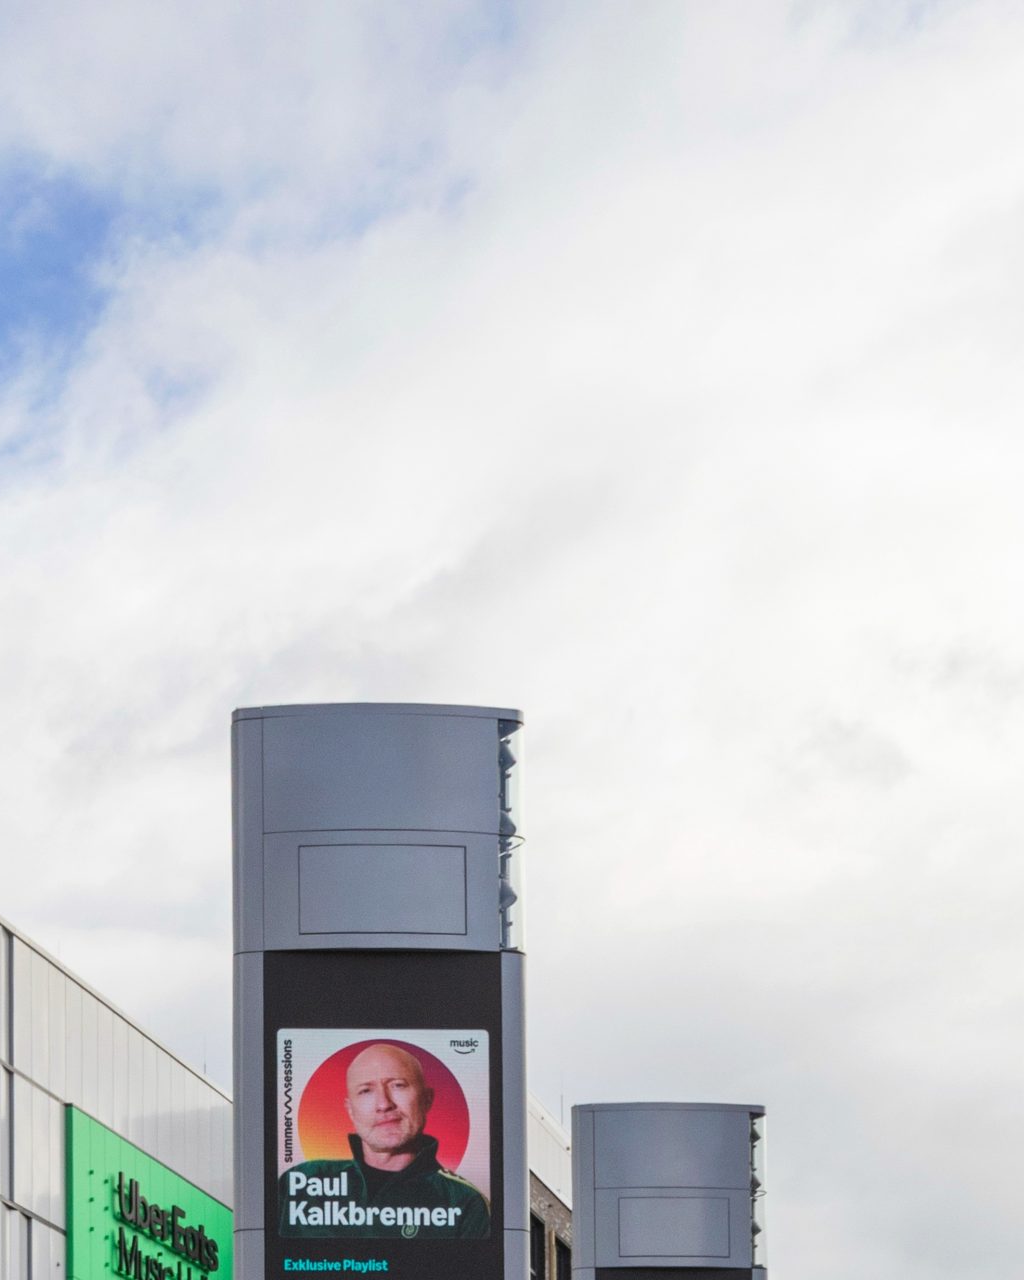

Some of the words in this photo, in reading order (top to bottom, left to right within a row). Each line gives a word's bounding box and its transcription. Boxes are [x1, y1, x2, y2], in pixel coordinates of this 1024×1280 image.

[450, 1038, 479, 1047] music
[282, 1039, 293, 1089] sessions
[284, 1114, 293, 1163] summer
[289, 1172, 348, 1196] Paul
[117, 1171, 169, 1242] Uber
[171, 1205, 219, 1272] Eats
[289, 1201, 462, 1226] Kalkbrenner
[284, 1258, 341, 1271] Exklusive
[343, 1258, 388, 1273] Playlist
